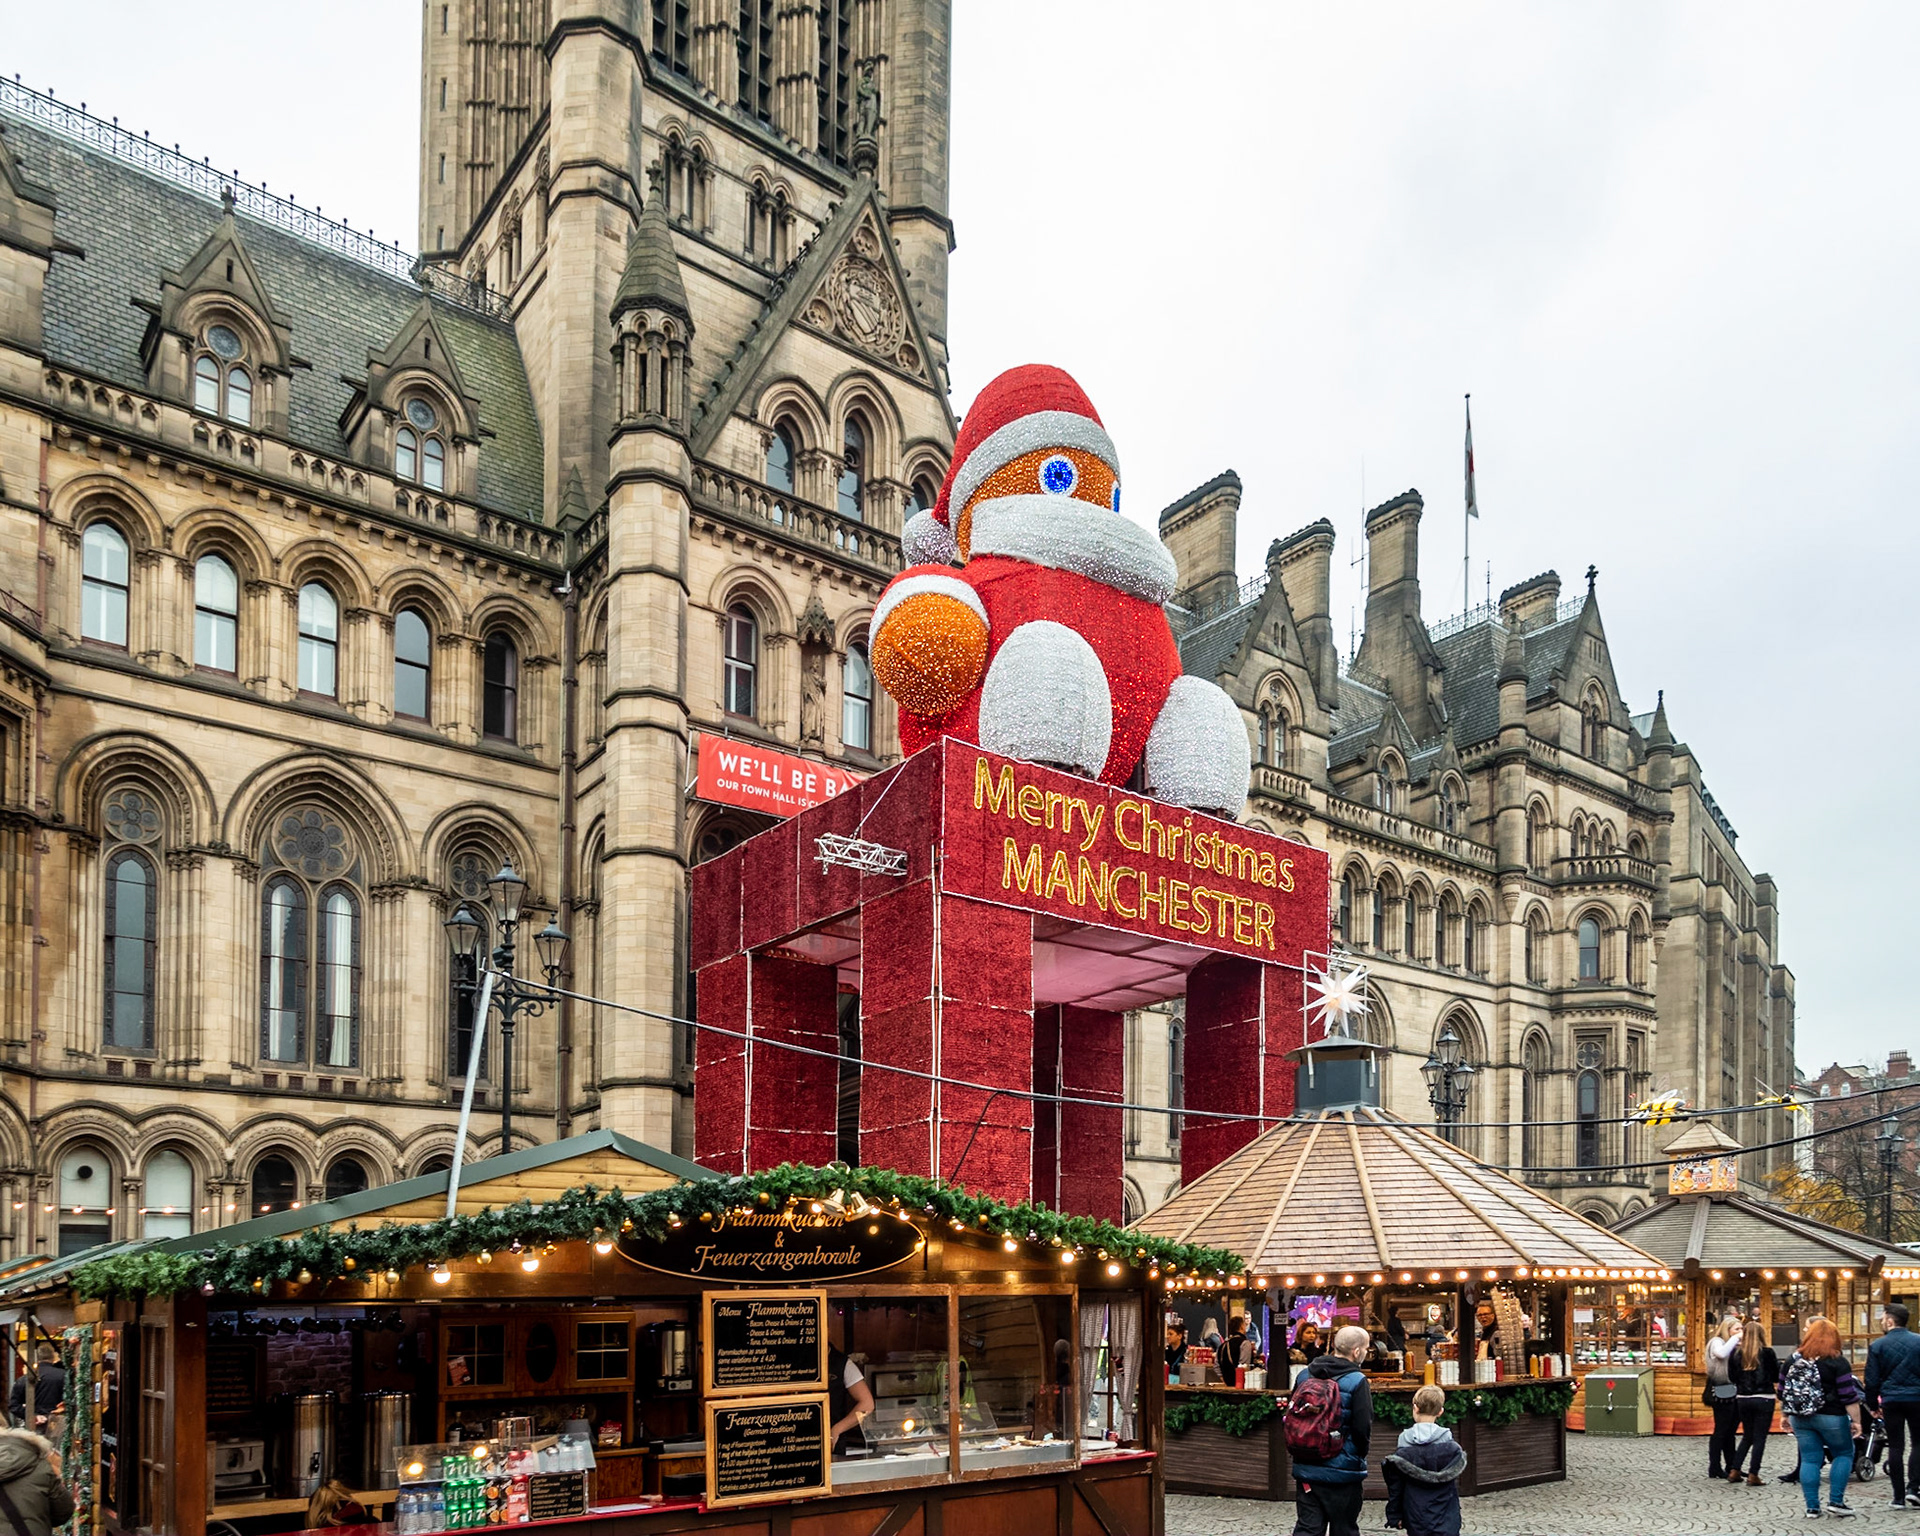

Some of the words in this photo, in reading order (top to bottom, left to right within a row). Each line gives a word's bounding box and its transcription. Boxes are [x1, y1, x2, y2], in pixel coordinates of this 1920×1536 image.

[716, 778, 739, 791] OUR
[741, 783, 770, 798] TOWN
[772, 791, 796, 804] HALL
[798, 798, 807, 808] IS
[791, 769, 817, 794] BE
[974, 756, 1105, 851] Merry
[1114, 799, 1296, 893] Christmas
[1002, 837, 1276, 951] MANCHESTER
[774, 1230, 784, 1248] &
[690, 1244, 862, 1273] Feuerzangenbowle
[718, 1306, 742, 1316] Menu
[746, 1302, 814, 1320] Flammkuchen
[726, 1408, 813, 1430] Feuerzangenbowle
[744, 1428, 768, 1437] (German
